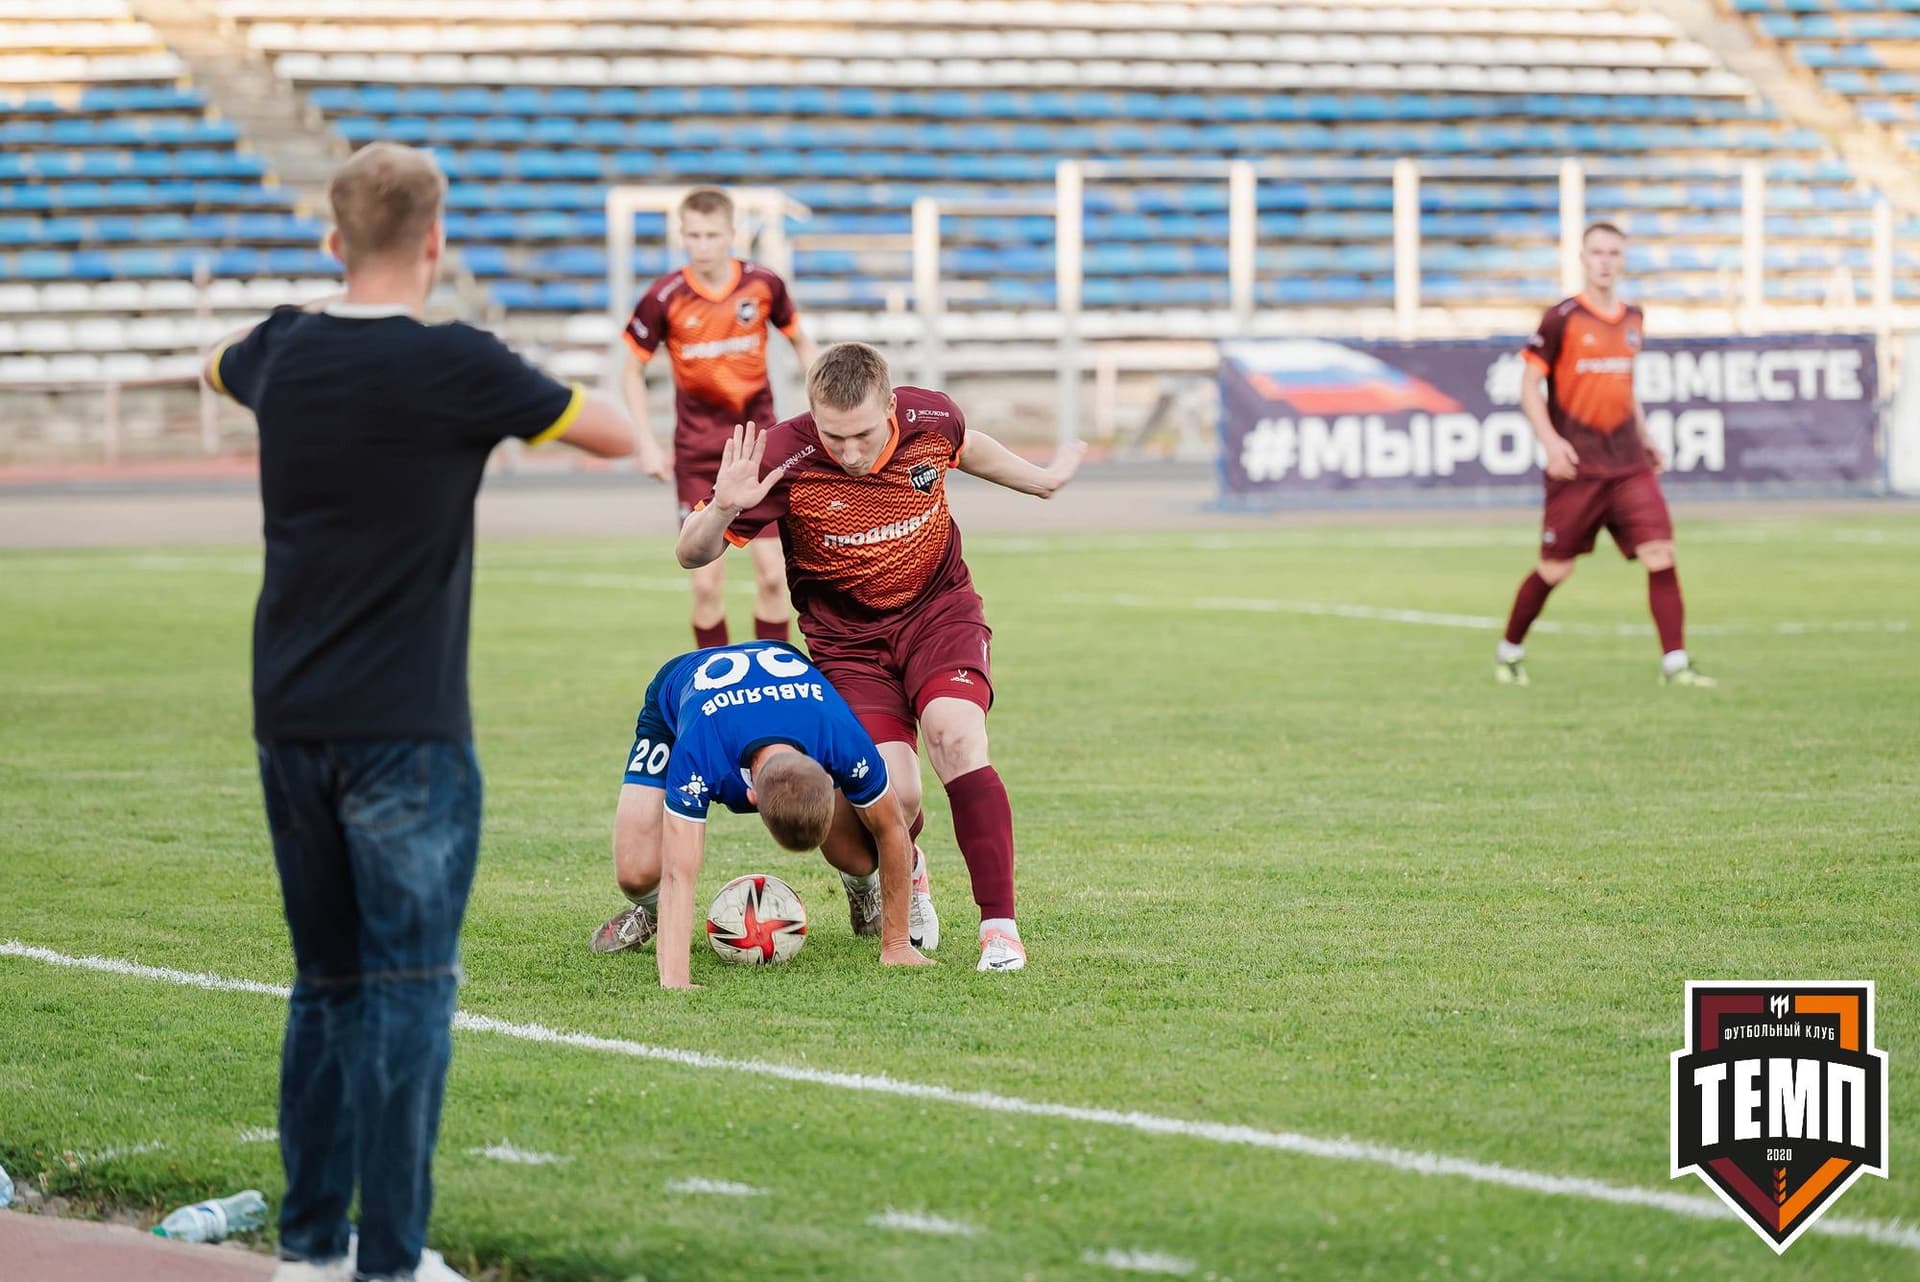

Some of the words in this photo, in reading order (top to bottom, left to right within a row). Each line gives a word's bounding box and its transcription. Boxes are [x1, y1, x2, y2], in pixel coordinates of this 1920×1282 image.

[1484, 349, 1863, 406] #ВМЕСТЕ
[1239, 411, 1725, 482] #МЫРОЯ
[912, 468, 937, 489] ТЕМП
[693, 646, 809, 691] 20
[701, 682, 824, 717] ЗАВЬЯЛОВ
[628, 738, 670, 775] 20
